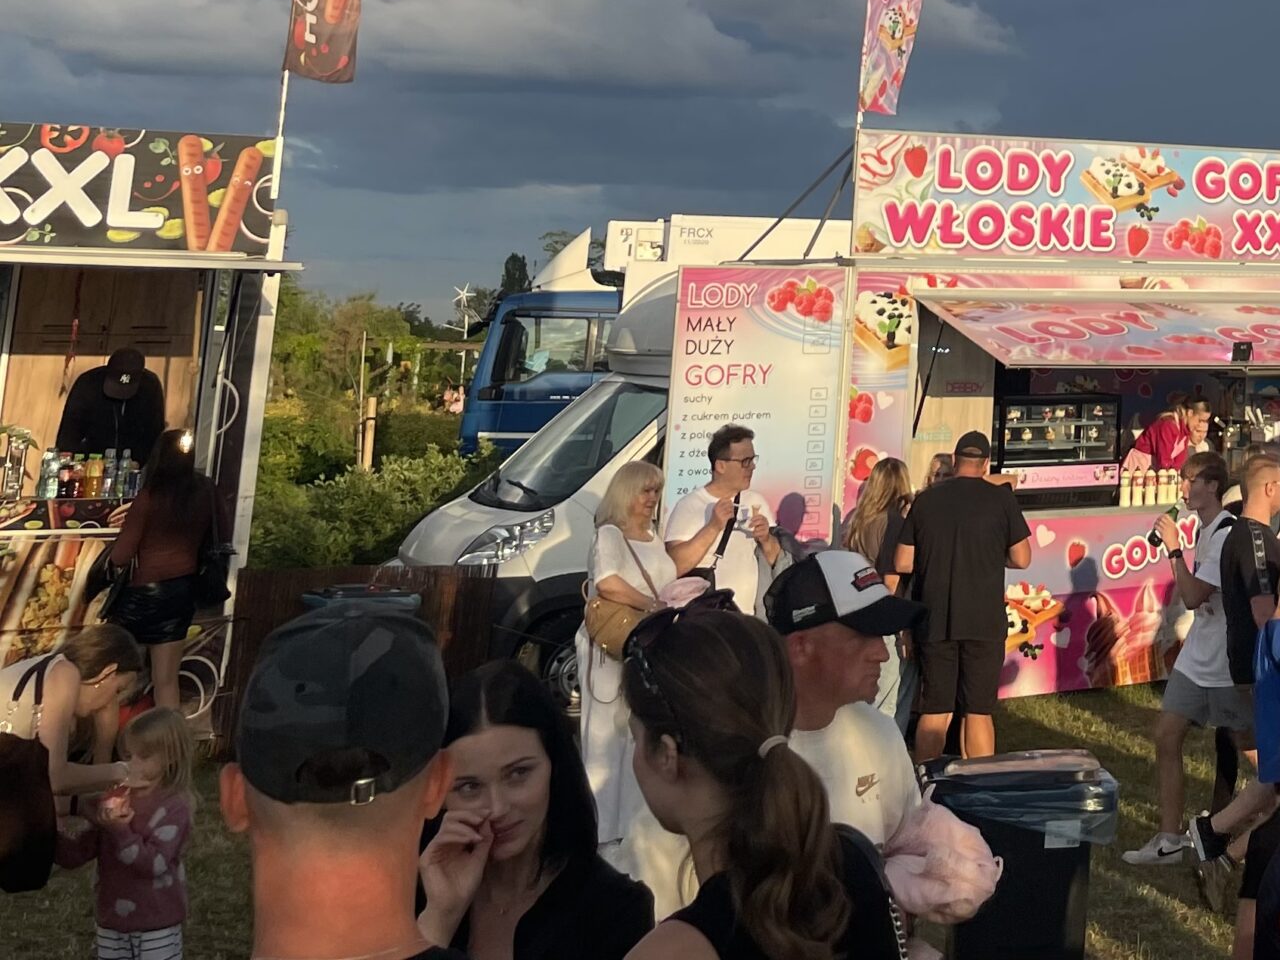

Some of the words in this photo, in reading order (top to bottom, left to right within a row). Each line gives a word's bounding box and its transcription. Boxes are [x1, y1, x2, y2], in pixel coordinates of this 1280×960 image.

[937, 144, 1075, 196] LODY
[882, 199, 1117, 253] WŁOSKIE
[687, 282, 758, 308] LODY
[686, 316, 737, 332] MAŁY
[994, 310, 1158, 345] LODY
[685, 335, 735, 355] DUŻY
[684, 363, 773, 386] GOFRY
[683, 391, 713, 405] suchy
[691, 411, 730, 421] cukrem
[731, 411, 771, 421] pudrem
[681, 432, 686, 440] z
[689, 430, 713, 442] pole
[679, 450, 685, 458] z
[688, 448, 708, 458] dże
[678, 468, 684, 476] z
[677, 486, 689, 495] ze
[1103, 514, 1200, 578] GOY
